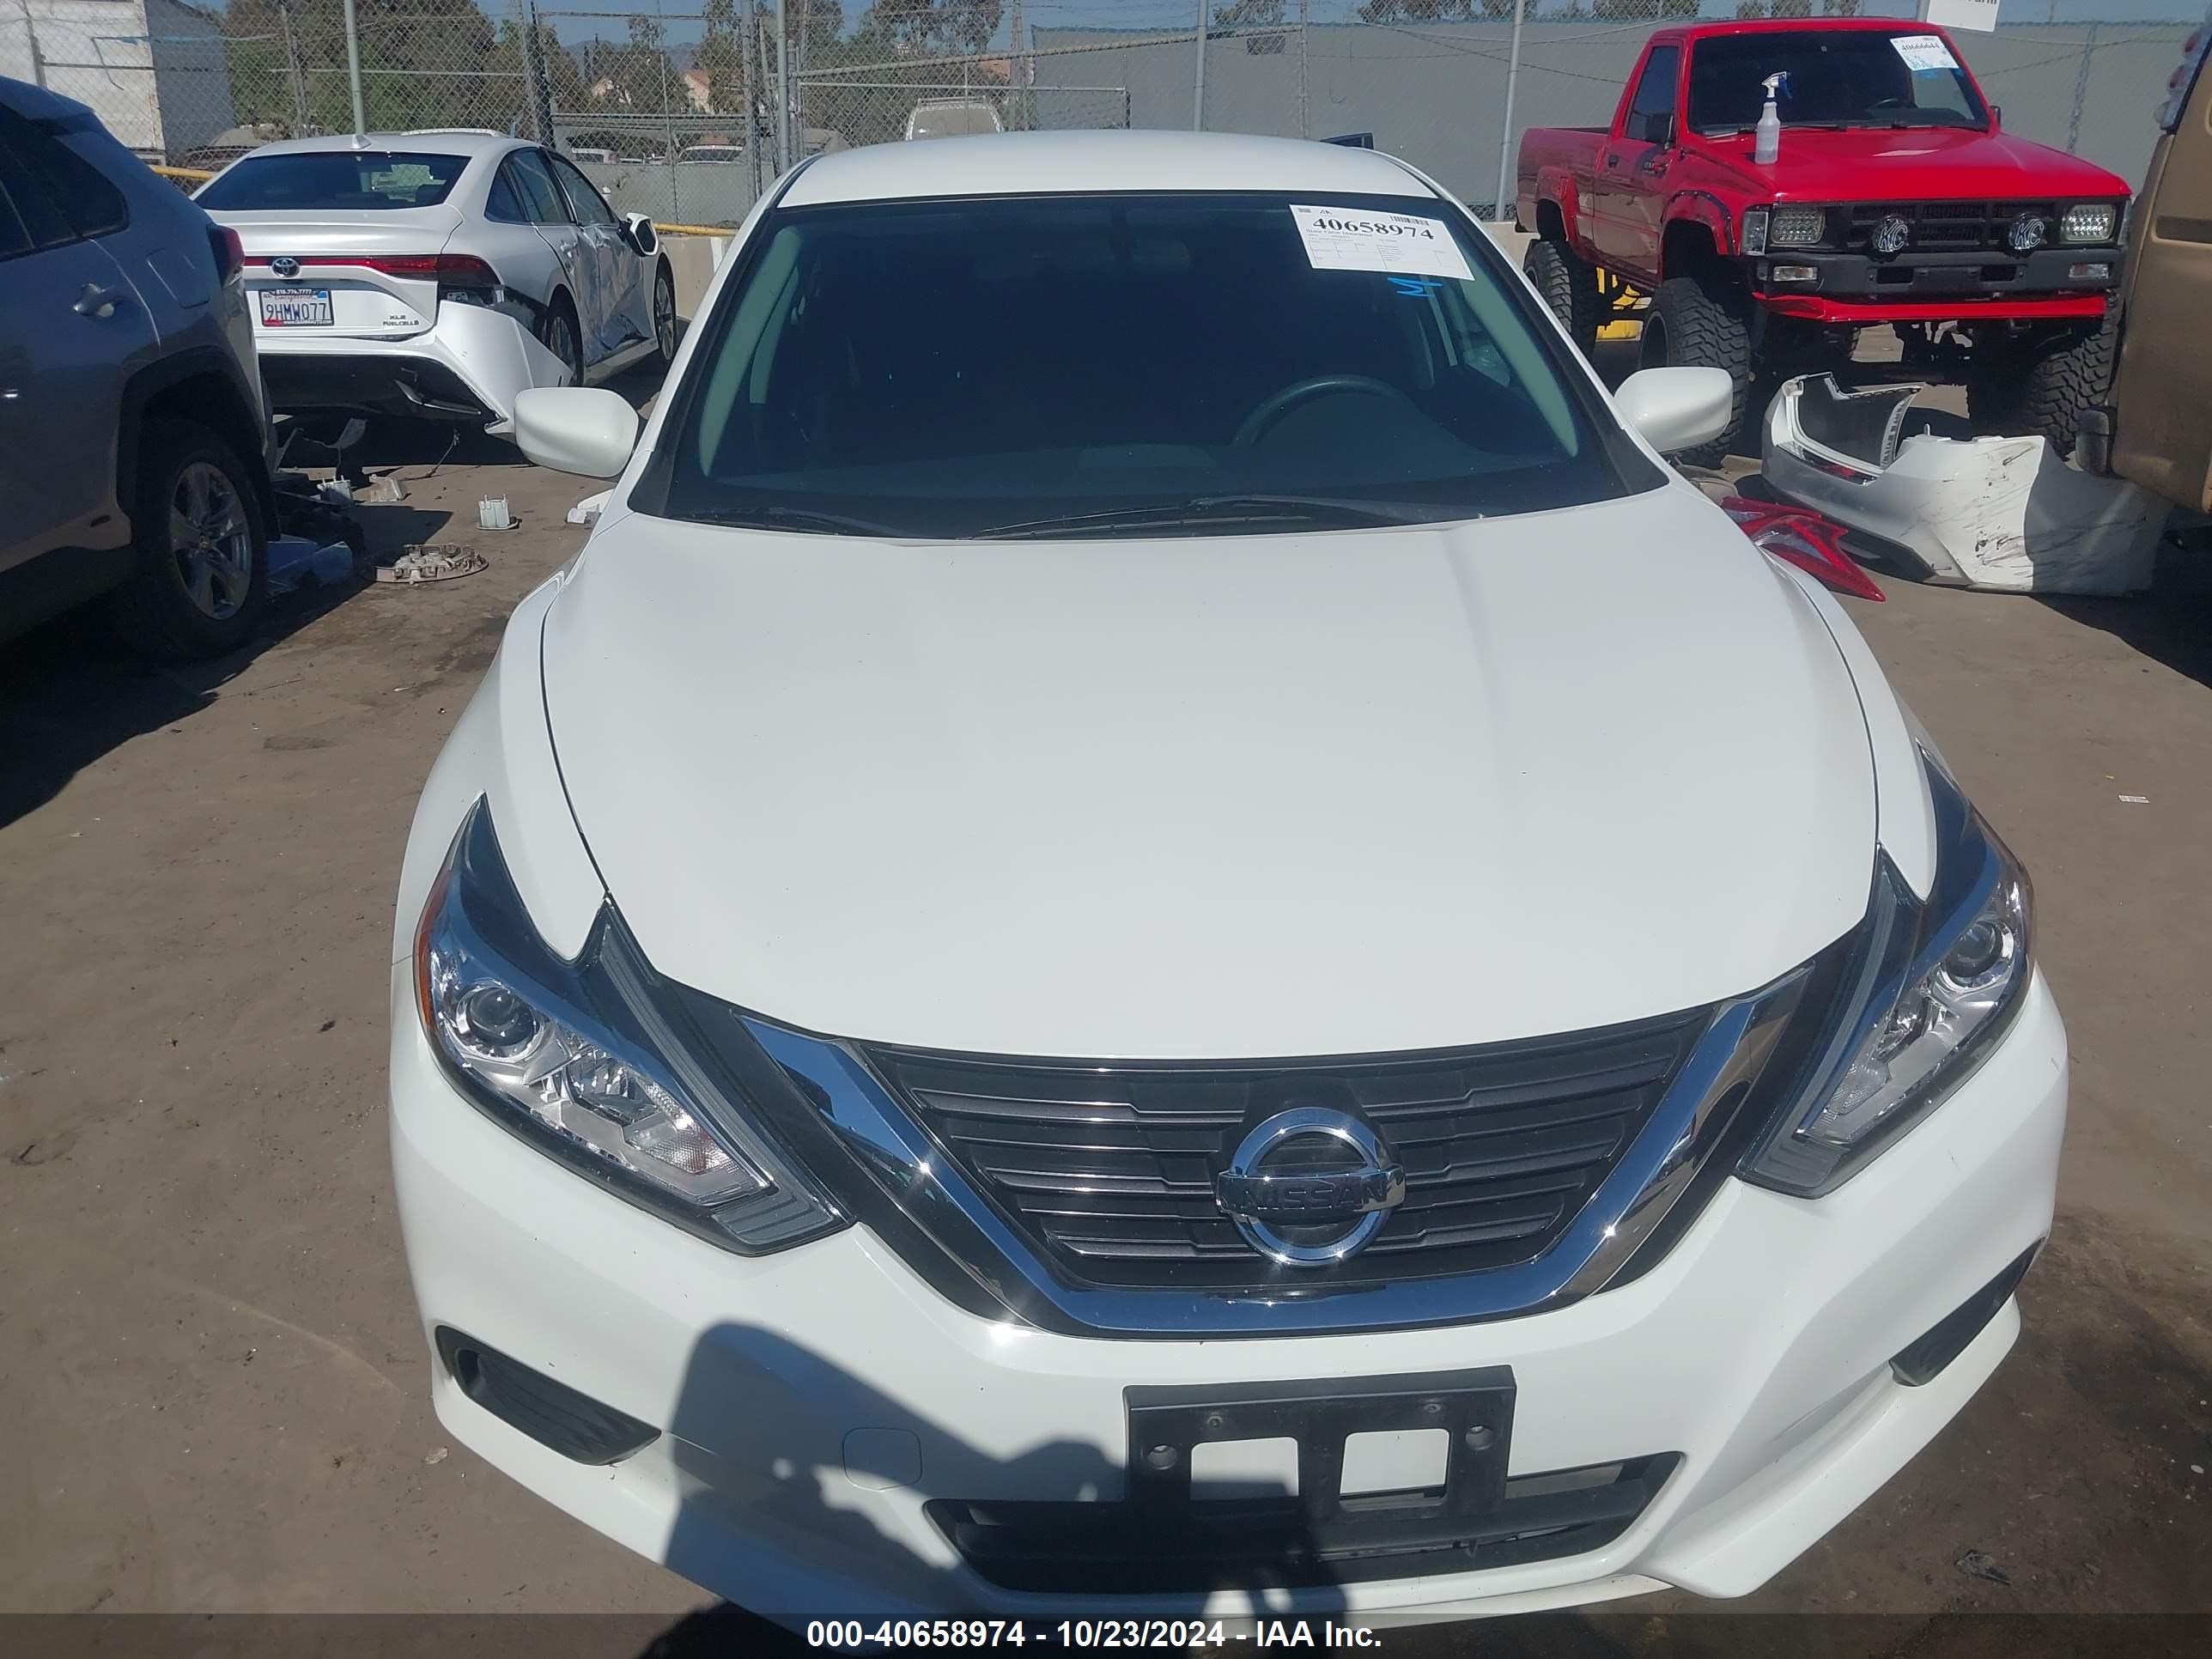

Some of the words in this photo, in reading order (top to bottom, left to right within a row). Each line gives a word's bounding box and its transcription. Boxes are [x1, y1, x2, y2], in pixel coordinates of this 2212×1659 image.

[1313, 218, 1435, 240] 40658974
[1878, 219, 1908, 252] KC
[2014, 218, 2045, 249] KC
[266, 302, 326, 321] 9HMW077
[1239, 1182, 1386, 1211] NISSAN
